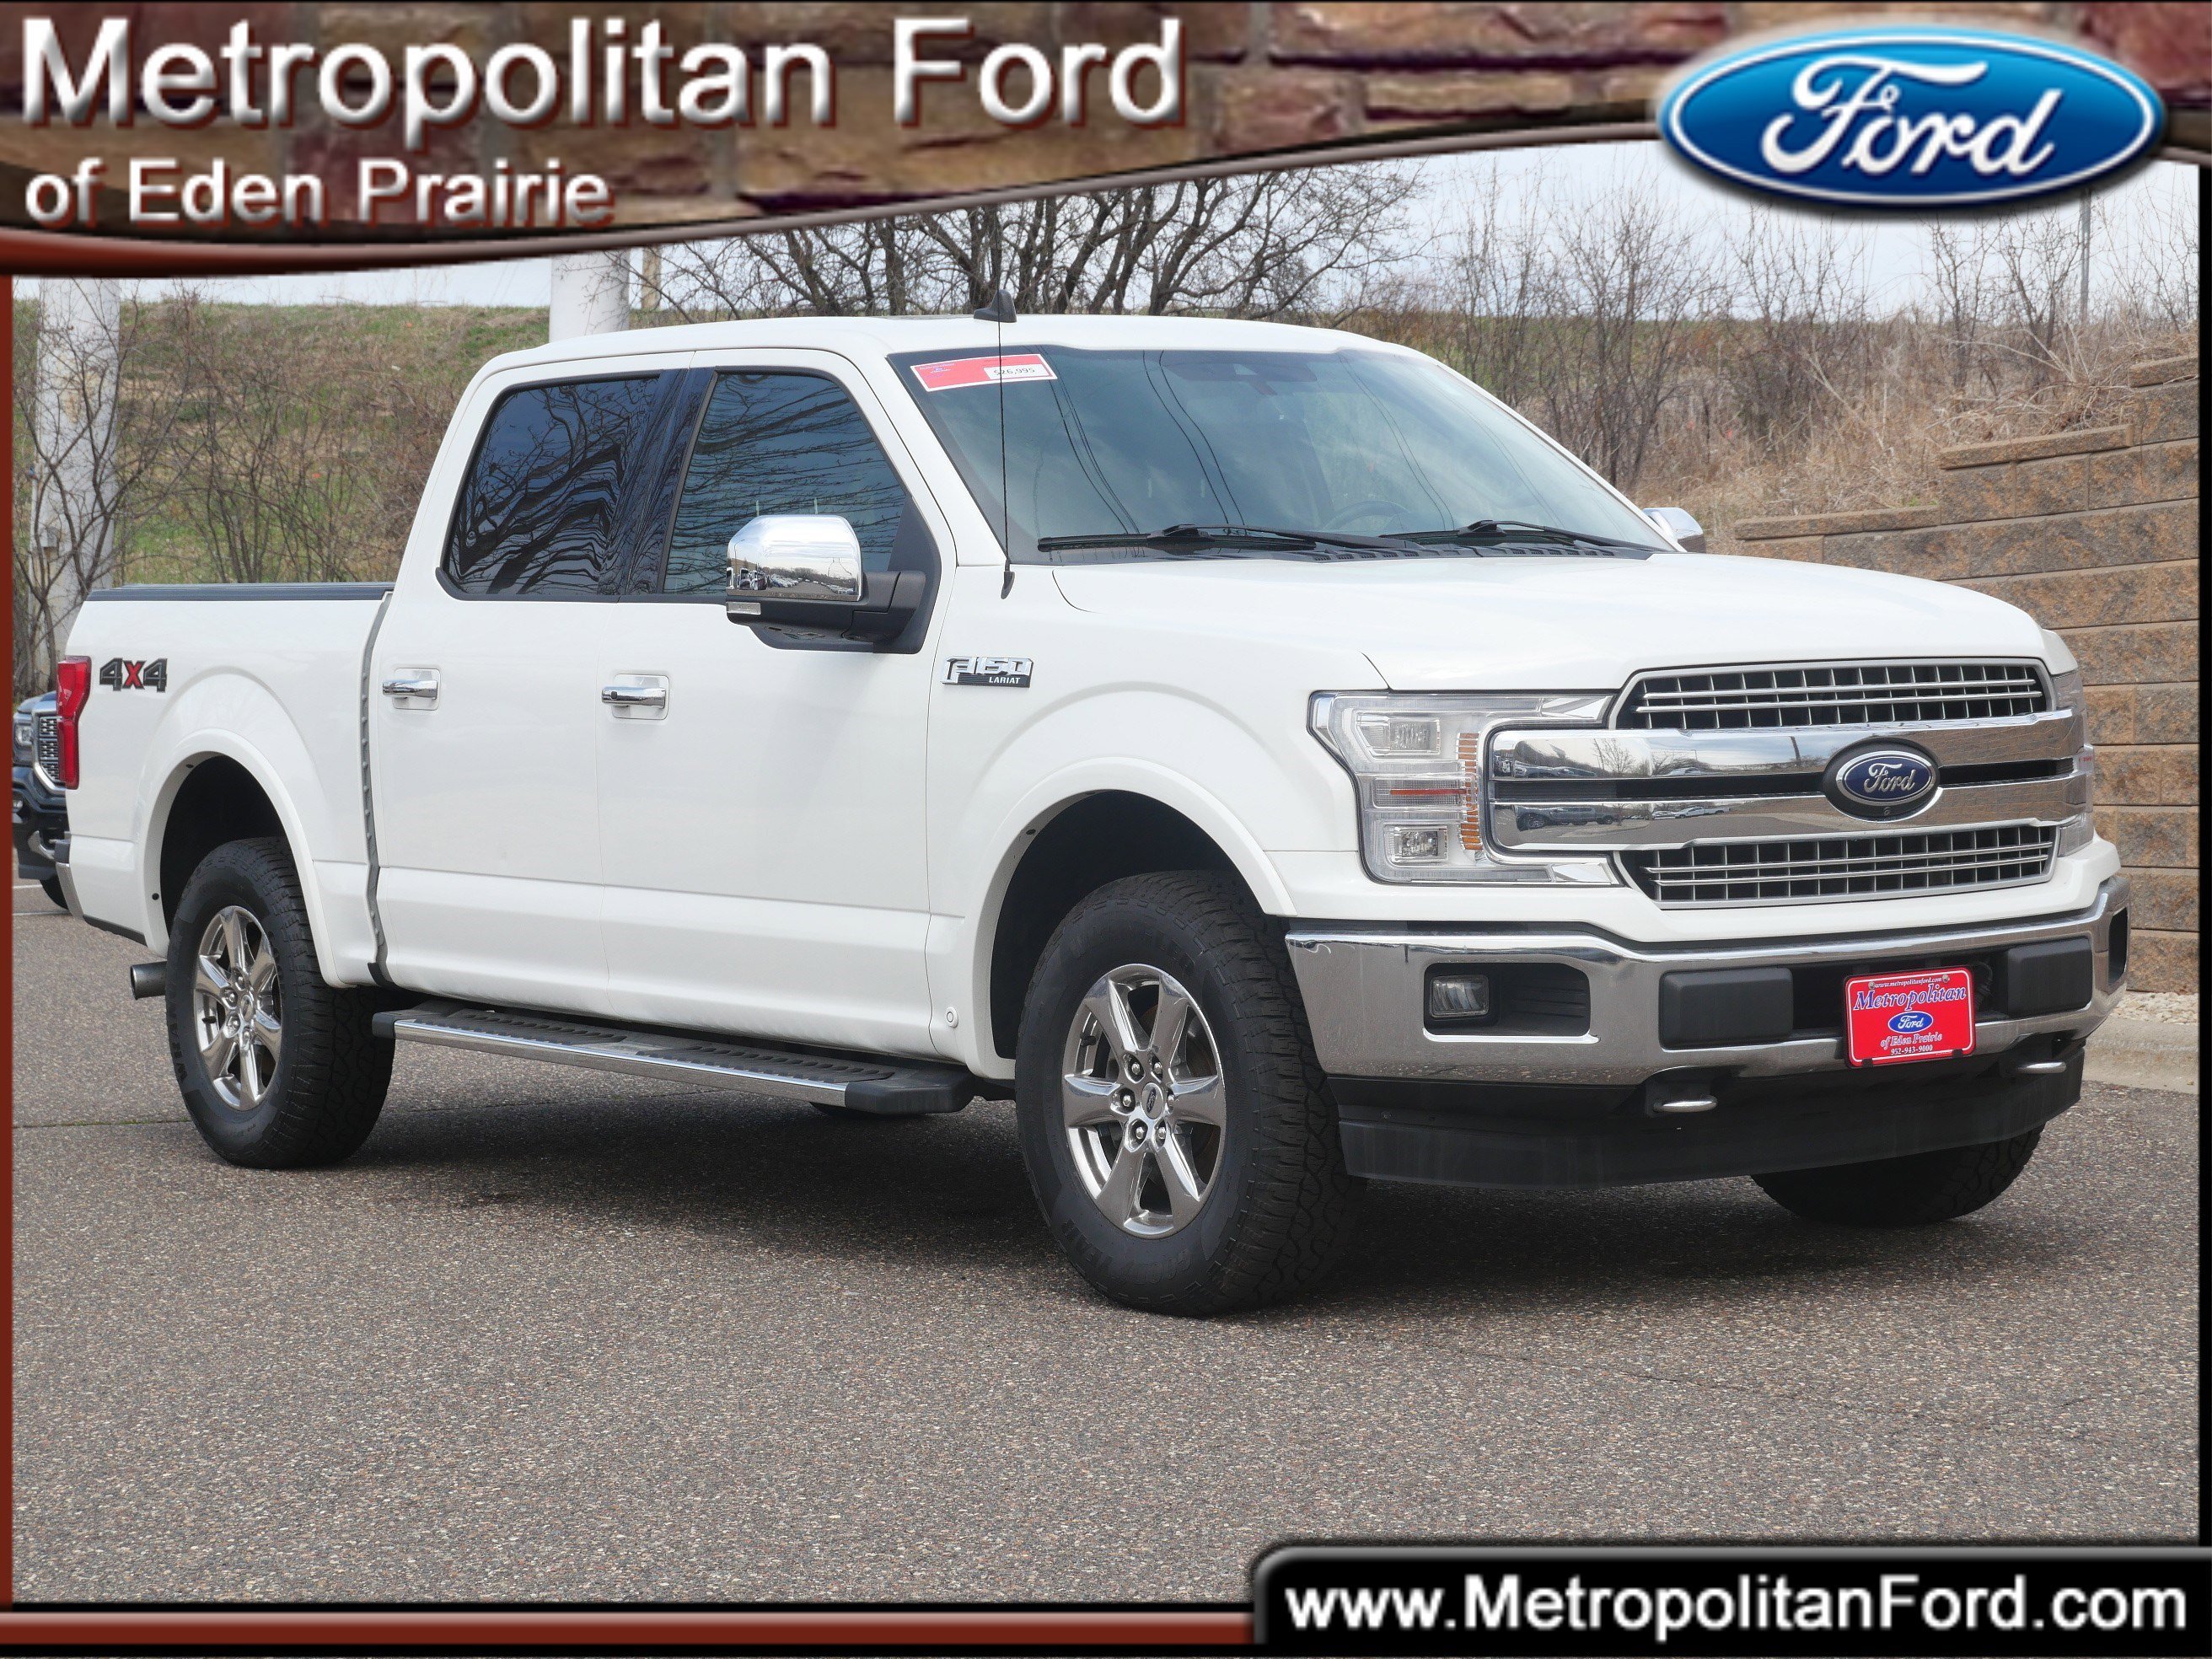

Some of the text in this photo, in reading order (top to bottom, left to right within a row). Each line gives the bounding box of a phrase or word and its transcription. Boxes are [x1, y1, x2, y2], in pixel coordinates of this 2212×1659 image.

[988, 676, 1021, 685] LARIAT
[1864, 763, 1916, 793] Ford
[1853, 984, 1966, 1011] Metropolitan
[1898, 1015, 1925, 1029] Ford
[1880, 1031, 1943, 1050] of Eden Prairie
[1891, 1044, 1933, 1055] 952-943-9000
